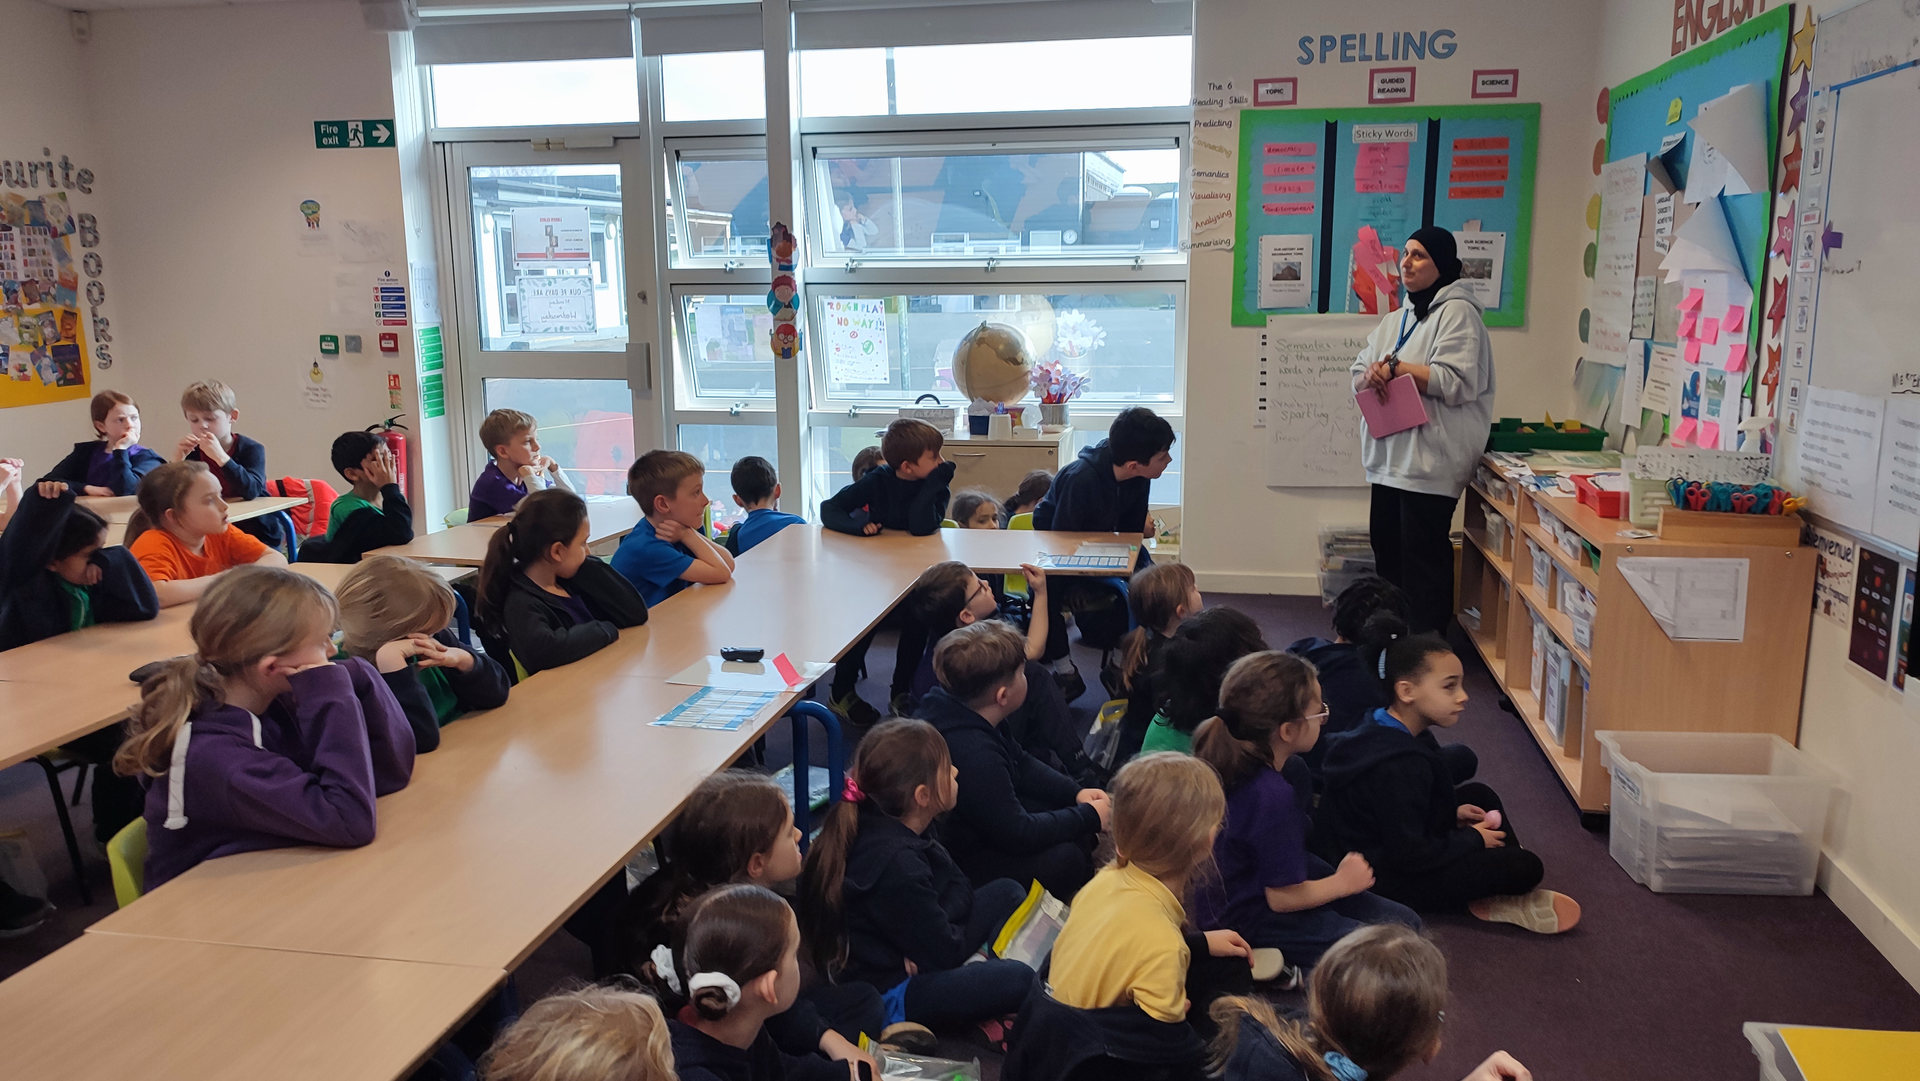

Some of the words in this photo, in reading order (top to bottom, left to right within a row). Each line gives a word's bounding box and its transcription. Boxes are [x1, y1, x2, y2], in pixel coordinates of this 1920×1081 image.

[1296, 29, 1458, 65] SPELLING
[1208, 82, 1223, 90] The
[1227, 81, 1233, 90] 6
[1481, 78, 1510, 86] SCIENCE
[1192, 98, 1224, 107] Reading
[1229, 96, 1248, 104] Skills
[1194, 119, 1232, 128] Predicting
[321, 124, 339, 134] Fire
[1356, 129, 1383, 140] Sticky
[1384, 129, 1413, 138] Words
[322, 135, 339, 145] exit
[1191, 136, 1233, 158] Connecting
[0, 147, 95, 194] urite
[1191, 168, 1230, 178] Semantics
[1190, 191, 1231, 201] Visualising
[1195, 209, 1232, 229] Analysing
[1181, 238, 1231, 250] Summarising
[829, 302, 859, 312] ROUGH
[861, 303, 884, 314] PLAY
[837, 317, 849, 327] NO
[1343, 338, 1362, 349] the
[1295, 352, 1310, 362] the
